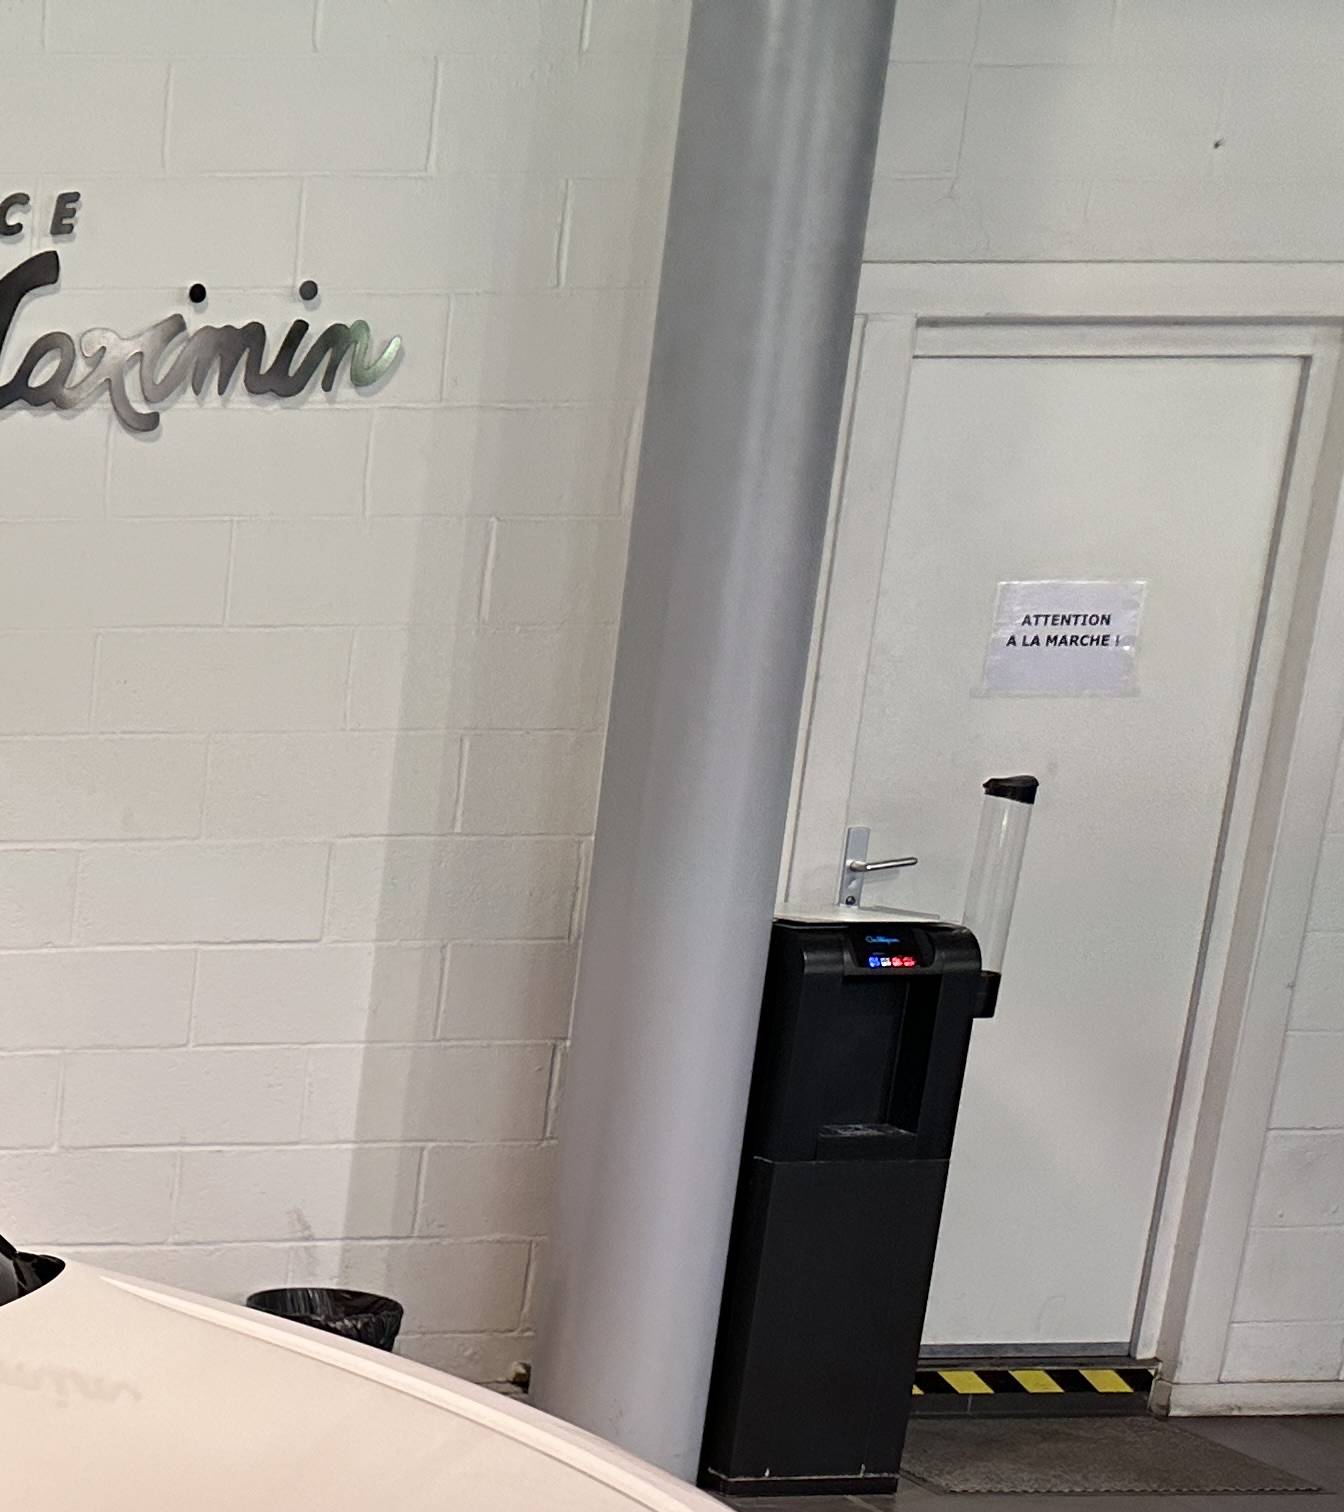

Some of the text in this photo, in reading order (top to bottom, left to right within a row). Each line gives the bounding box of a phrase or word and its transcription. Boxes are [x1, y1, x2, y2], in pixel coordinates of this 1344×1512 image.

[1020, 614, 1112, 626] ATTENTION
[1021, 635, 1041, 647] LA
[1045, 634, 1111, 647] MARCHE
